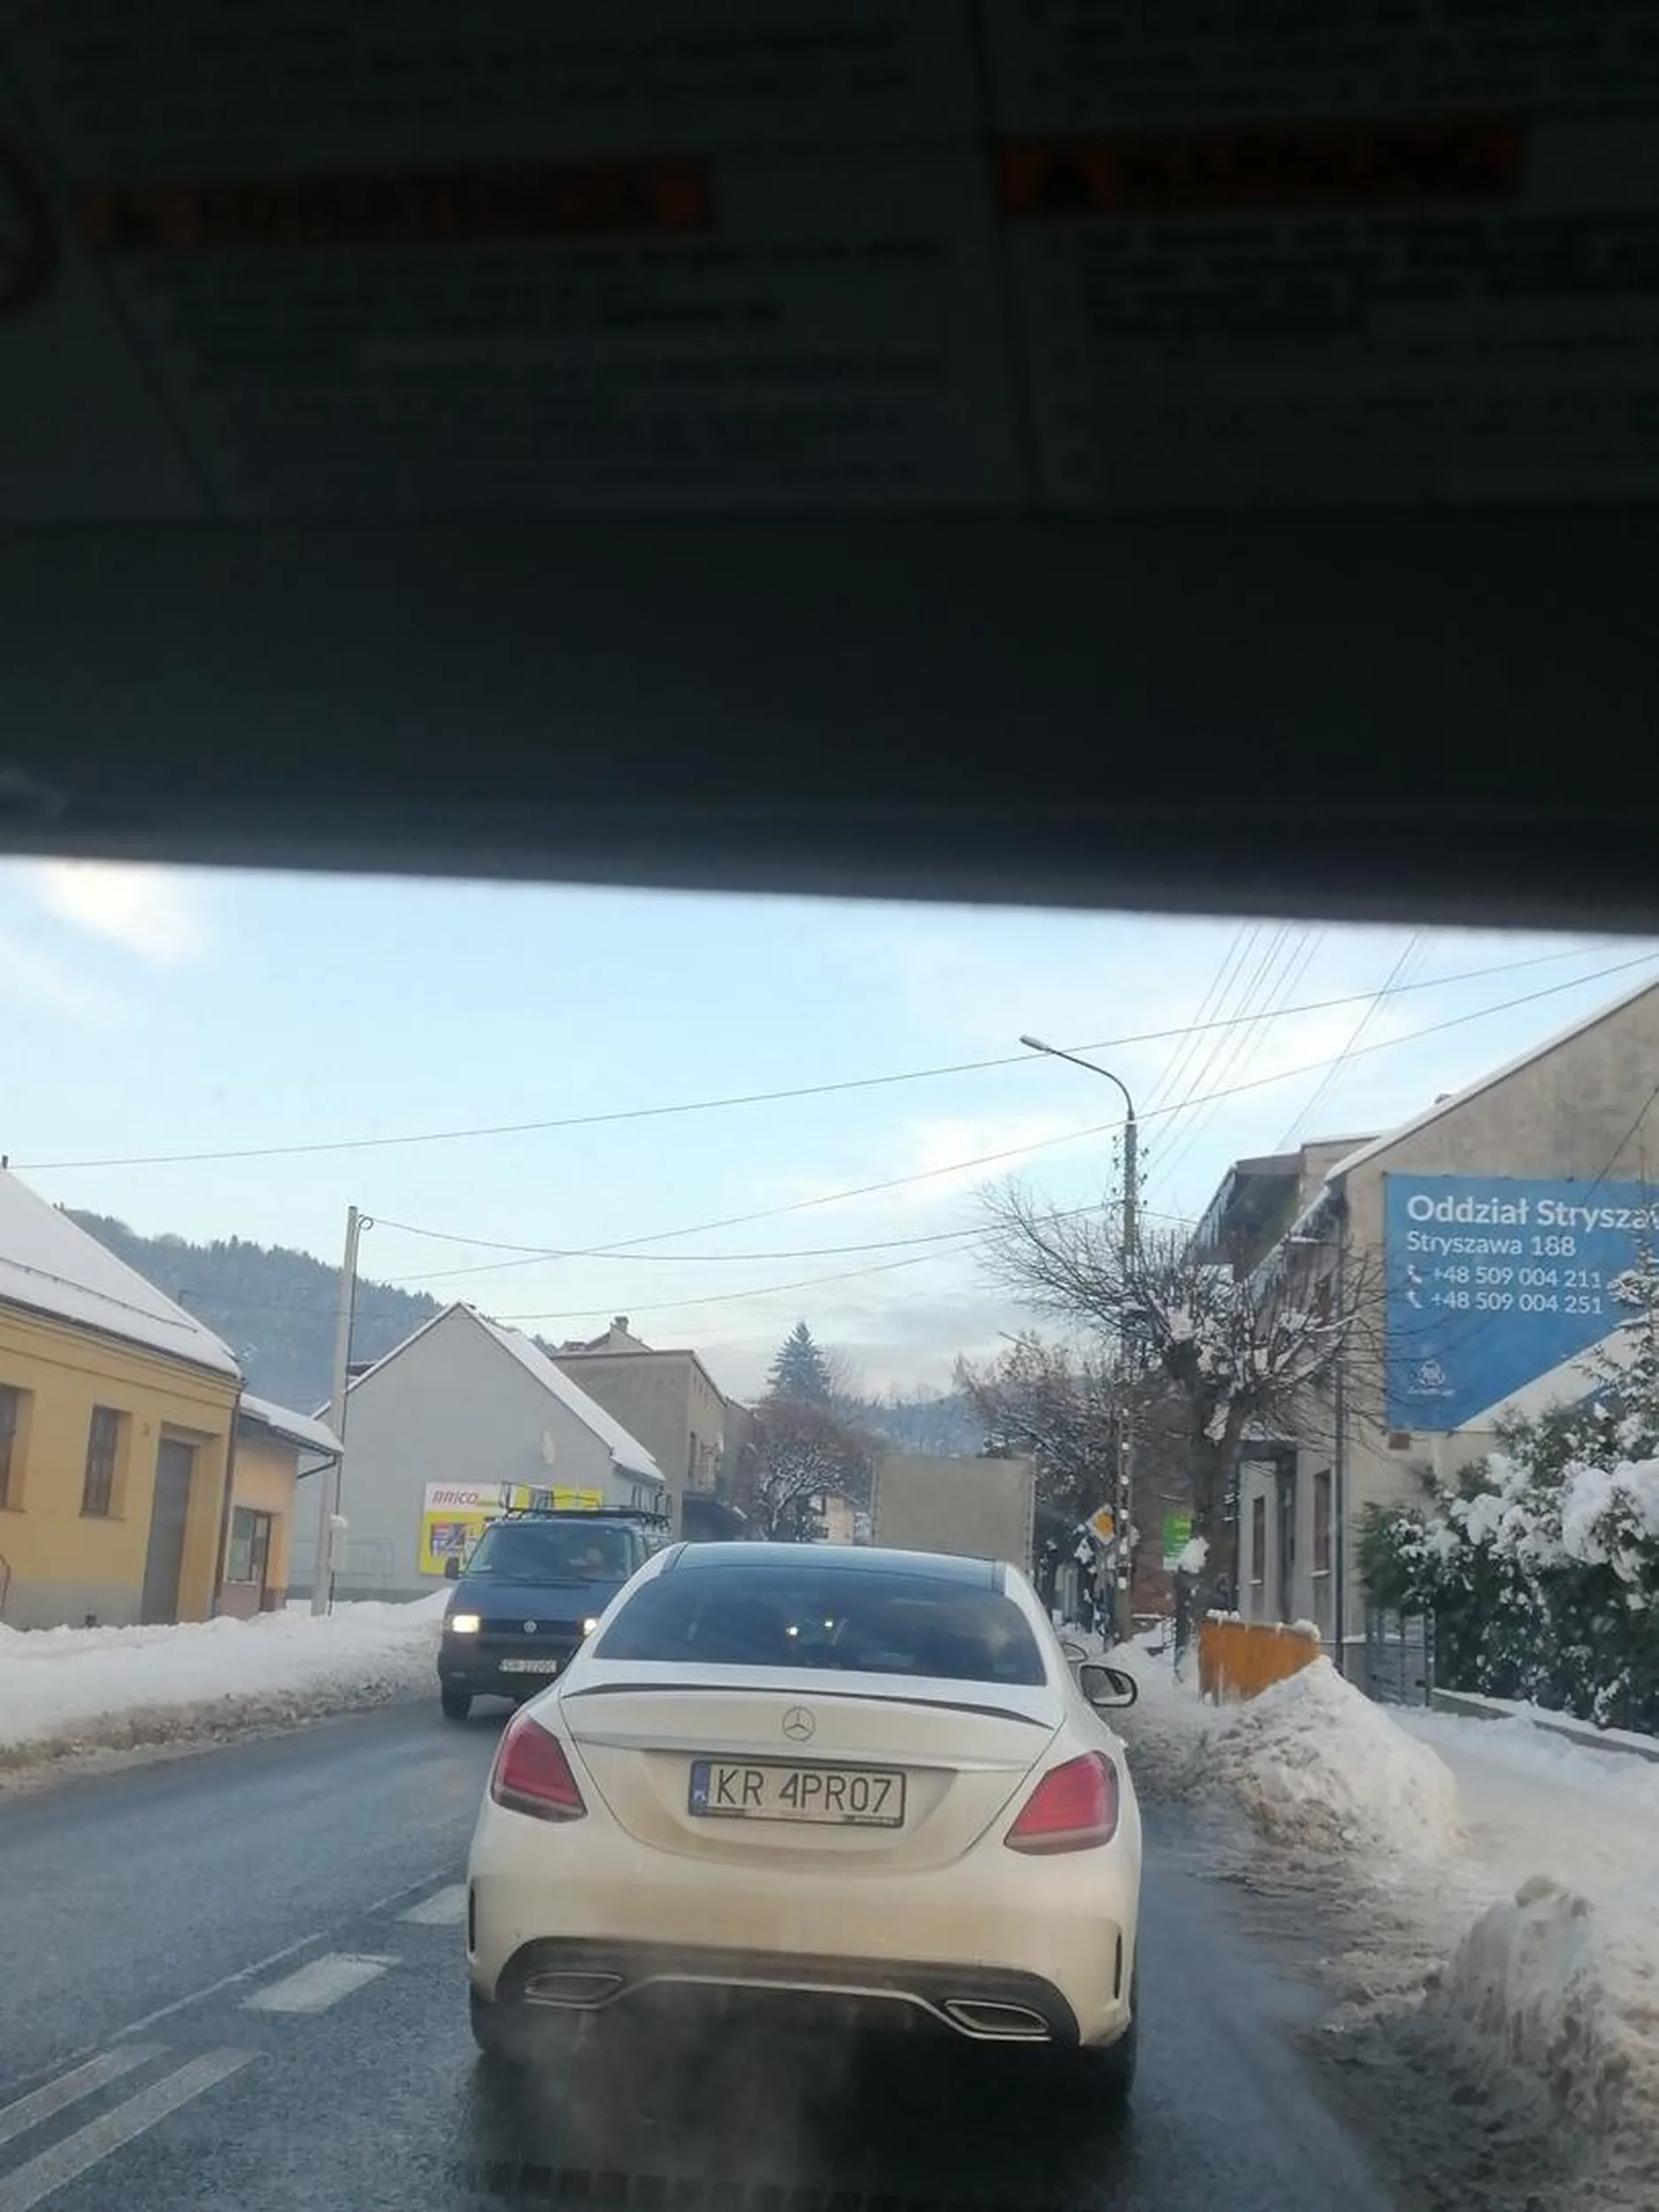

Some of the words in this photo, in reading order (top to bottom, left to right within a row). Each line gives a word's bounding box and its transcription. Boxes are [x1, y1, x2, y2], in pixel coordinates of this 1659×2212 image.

[1407, 1194, 1529, 1225] Oddział
[1406, 1230, 1523, 1256] Stryszawa
[1530, 1235, 1576, 1257] 188
[1432, 1265, 1471, 1284] +48
[1475, 1267, 1514, 1285] 509
[1518, 1268, 1557, 1286] 004
[1563, 1270, 1601, 1289] 211
[1431, 1291, 1471, 1310] +48
[1475, 1292, 1514, 1310] 509
[1518, 1293, 1558, 1312] 004
[1564, 1294, 1603, 1315] 251
[717, 1769, 764, 1806] KR
[778, 1771, 892, 1814] 4PR07
